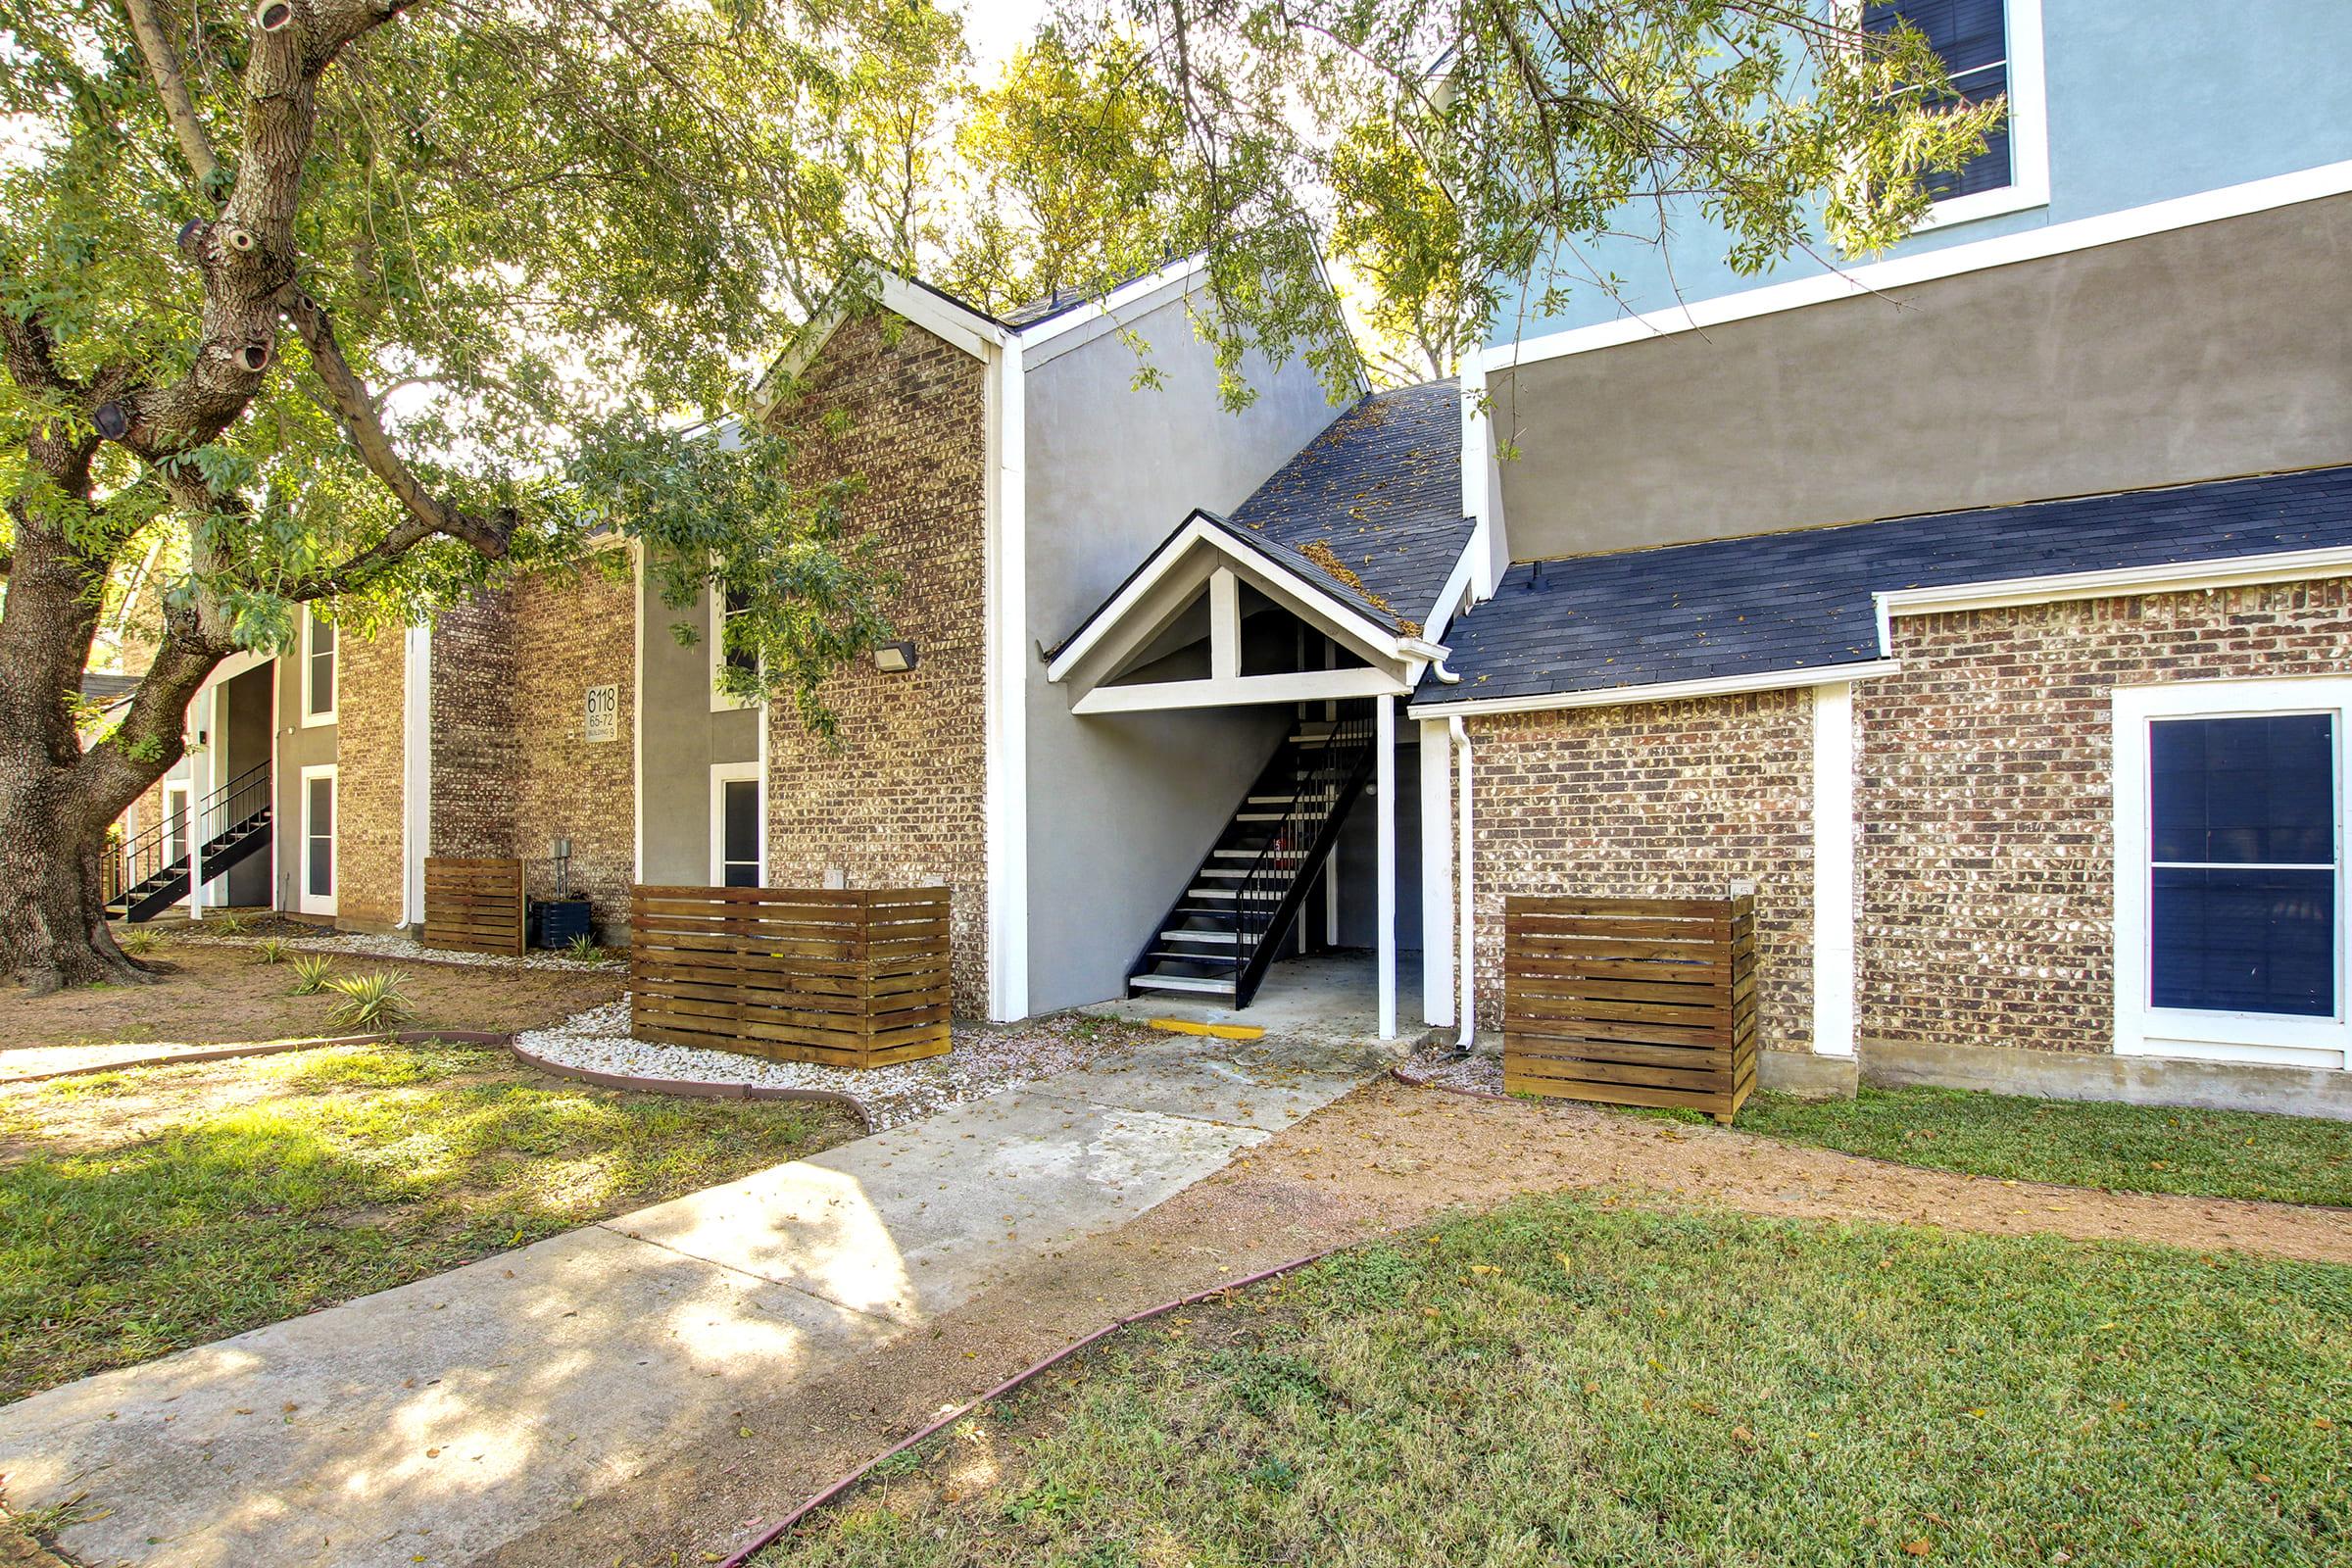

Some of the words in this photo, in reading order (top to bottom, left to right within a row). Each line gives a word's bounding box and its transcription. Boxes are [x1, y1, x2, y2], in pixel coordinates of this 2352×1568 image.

[588, 688, 614, 712] 6118
[590, 713, 612, 727] 65-72
[610, 727, 614, 738] 9
